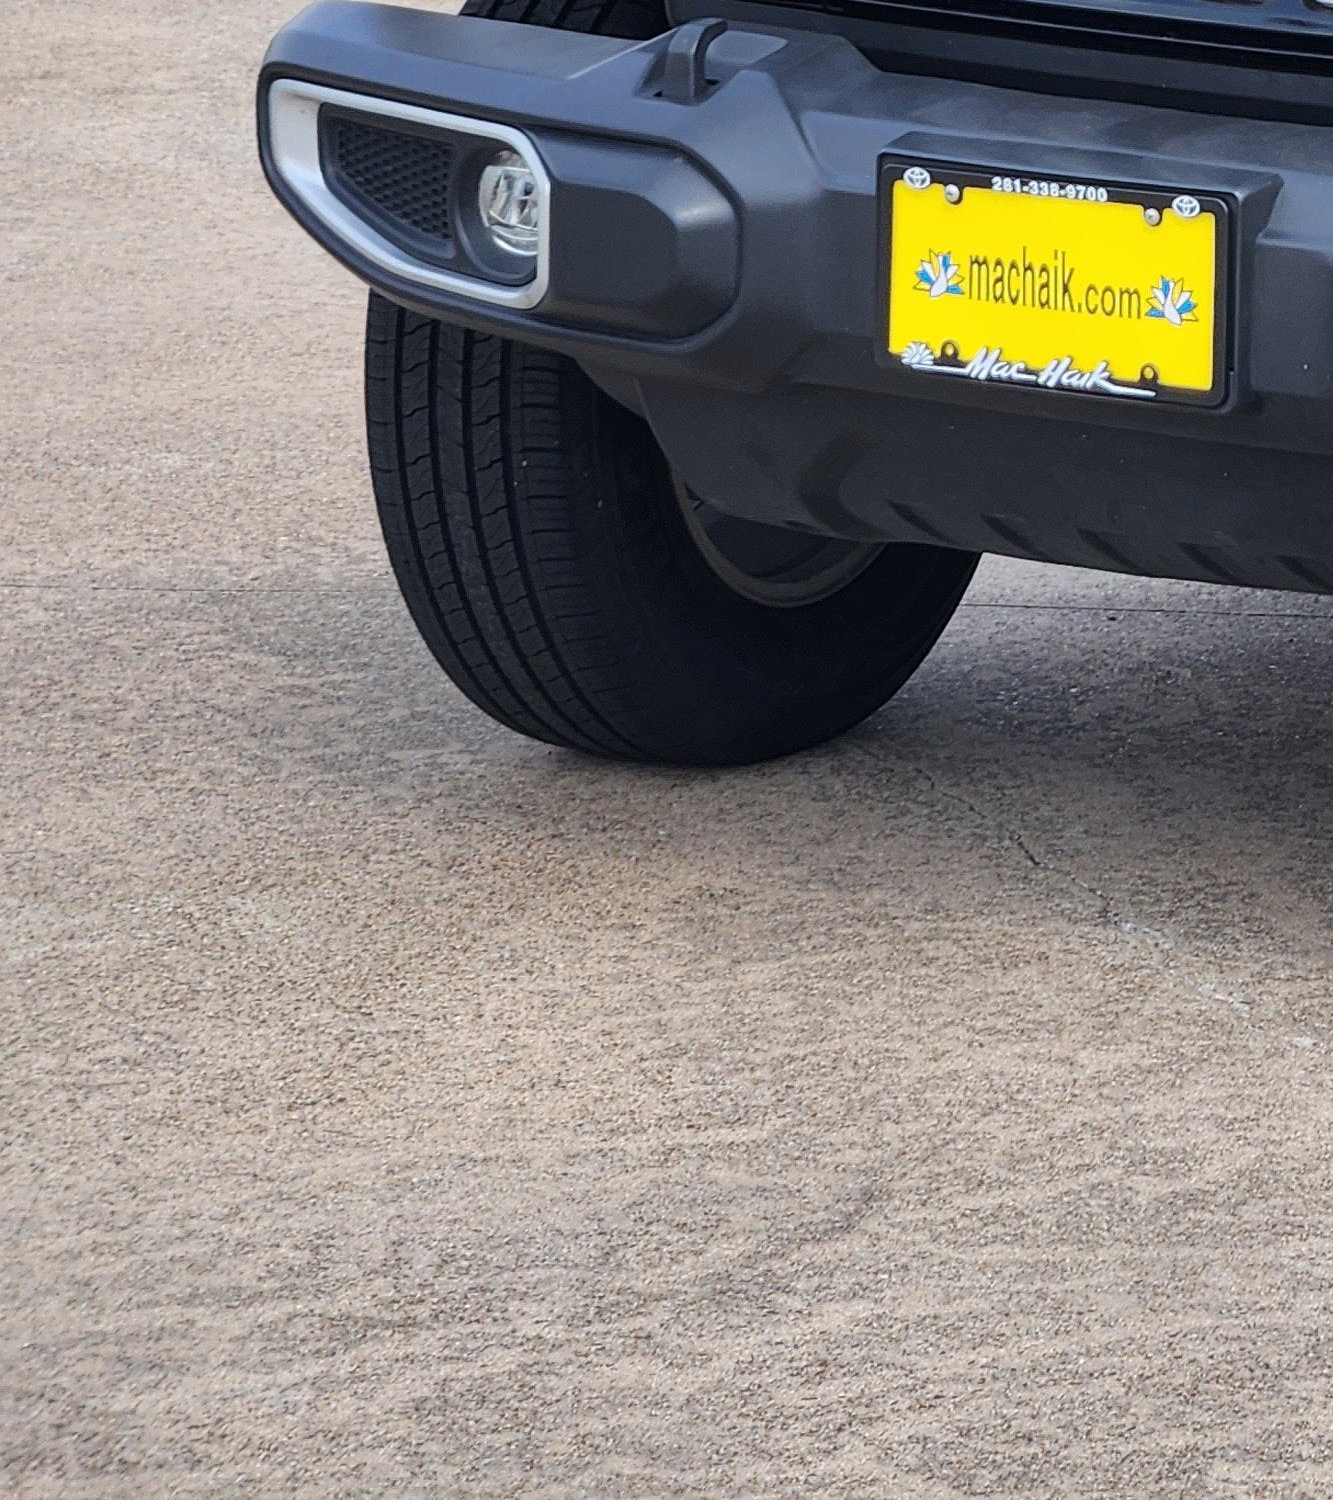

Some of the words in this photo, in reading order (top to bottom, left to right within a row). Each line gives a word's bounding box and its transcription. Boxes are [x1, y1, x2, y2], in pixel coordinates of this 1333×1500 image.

[991, 176, 1108, 203] 281-338-9700
[968, 246, 1142, 319] machaik.com
[963, 347, 1036, 381] Mac
[1037, 356, 1135, 393] Haik
